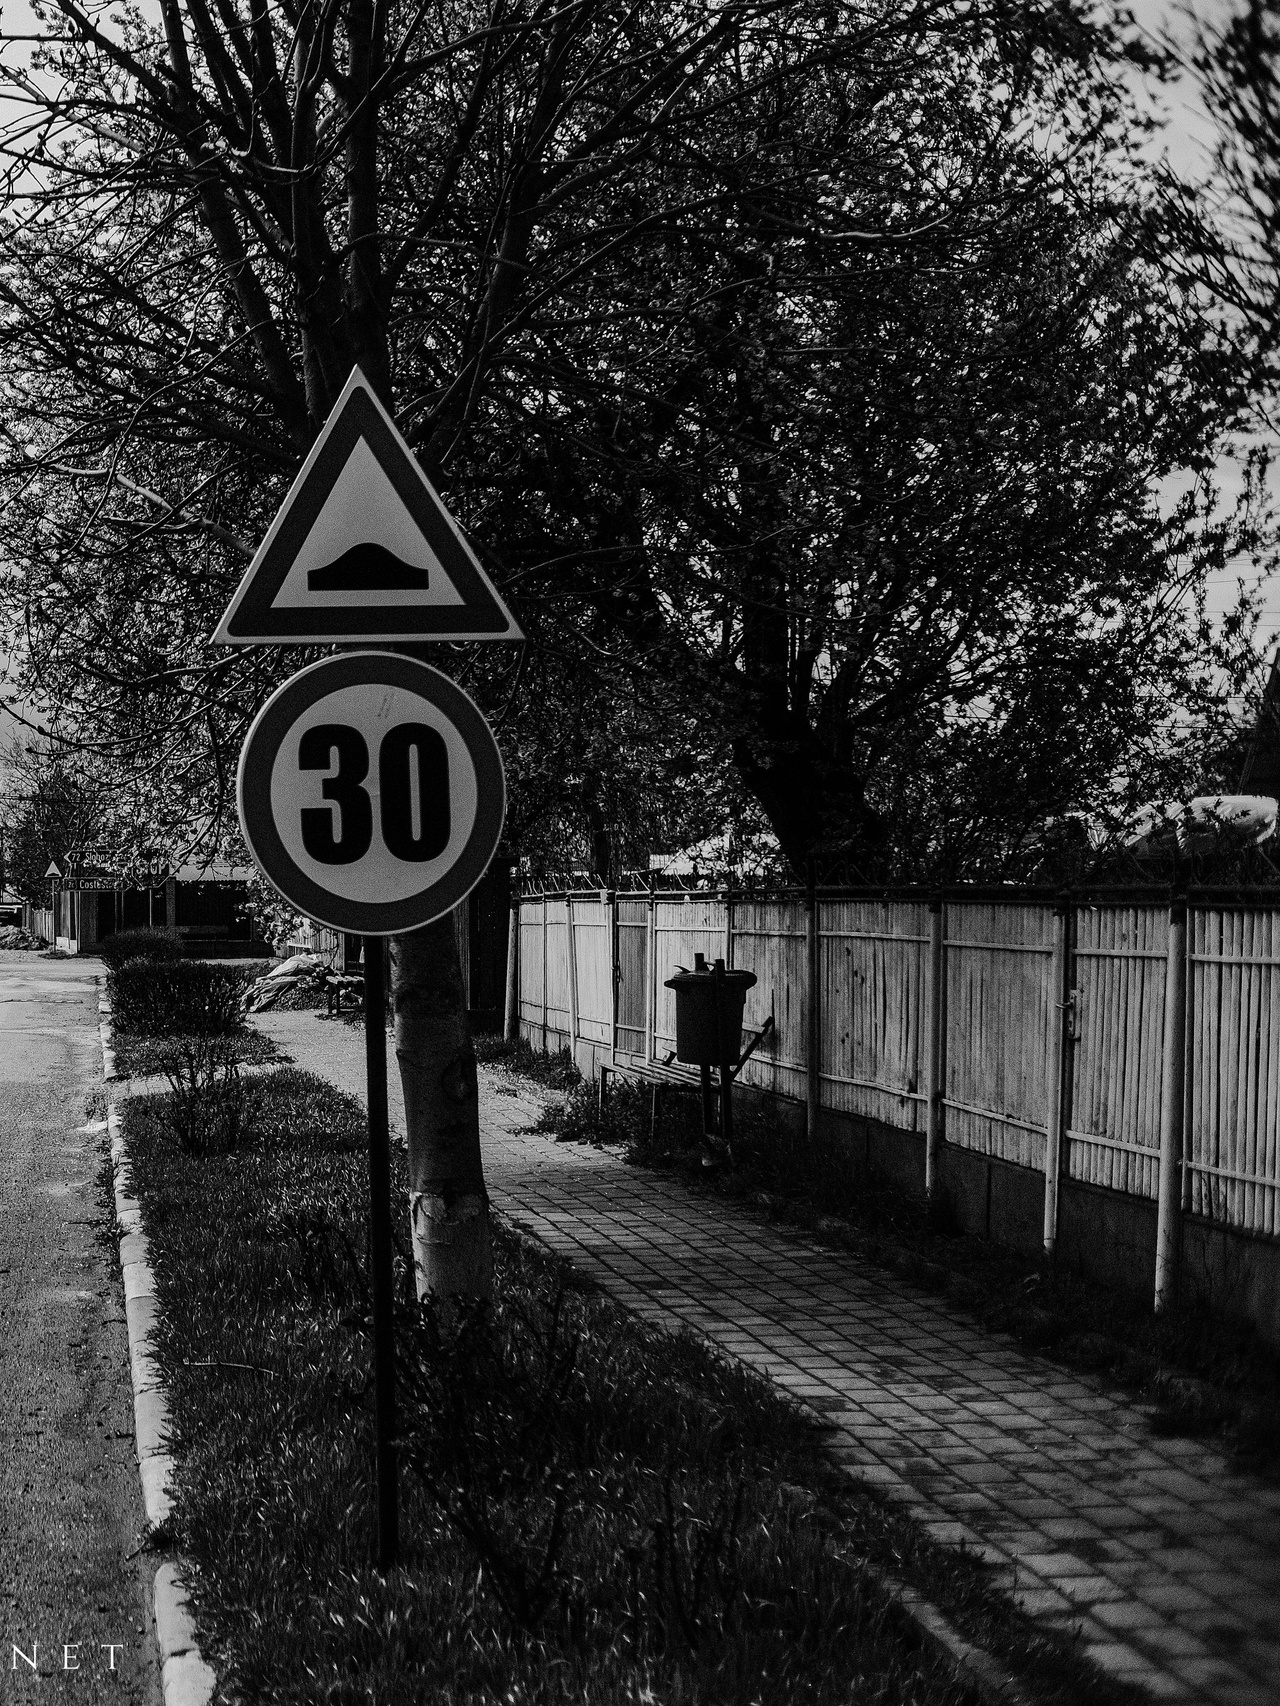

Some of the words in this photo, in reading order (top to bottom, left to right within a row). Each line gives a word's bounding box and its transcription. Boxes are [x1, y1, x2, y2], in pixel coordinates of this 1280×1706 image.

[298, 722, 451, 866] 30
[71, 853, 81, 862] 72
[85, 852, 114, 862] Sloboz
[135, 857, 168, 875] STOP
